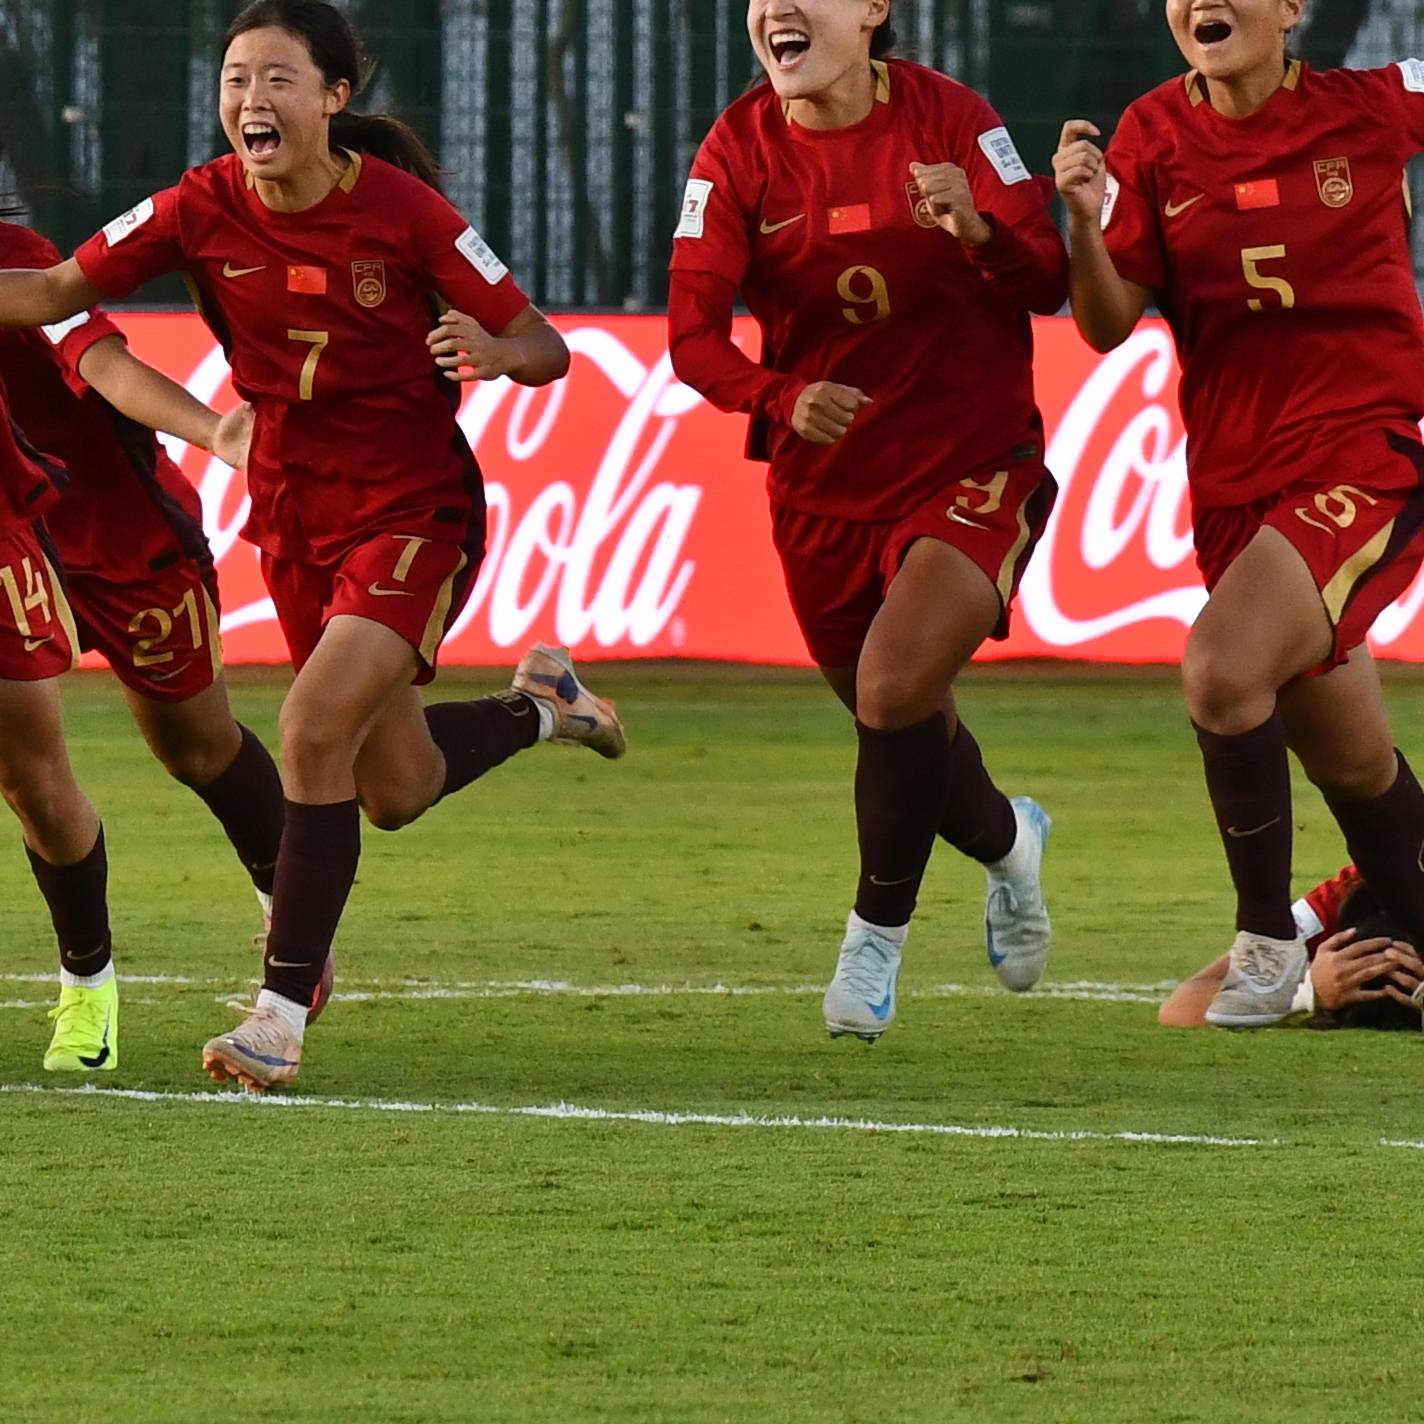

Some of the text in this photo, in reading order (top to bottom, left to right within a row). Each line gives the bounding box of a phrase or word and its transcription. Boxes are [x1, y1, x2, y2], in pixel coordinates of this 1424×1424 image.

[836, 265, 891, 324] 9
[1241, 244, 1295, 311] 5
[287, 328, 329, 401] 7
[128, 587, 204, 667] 21
